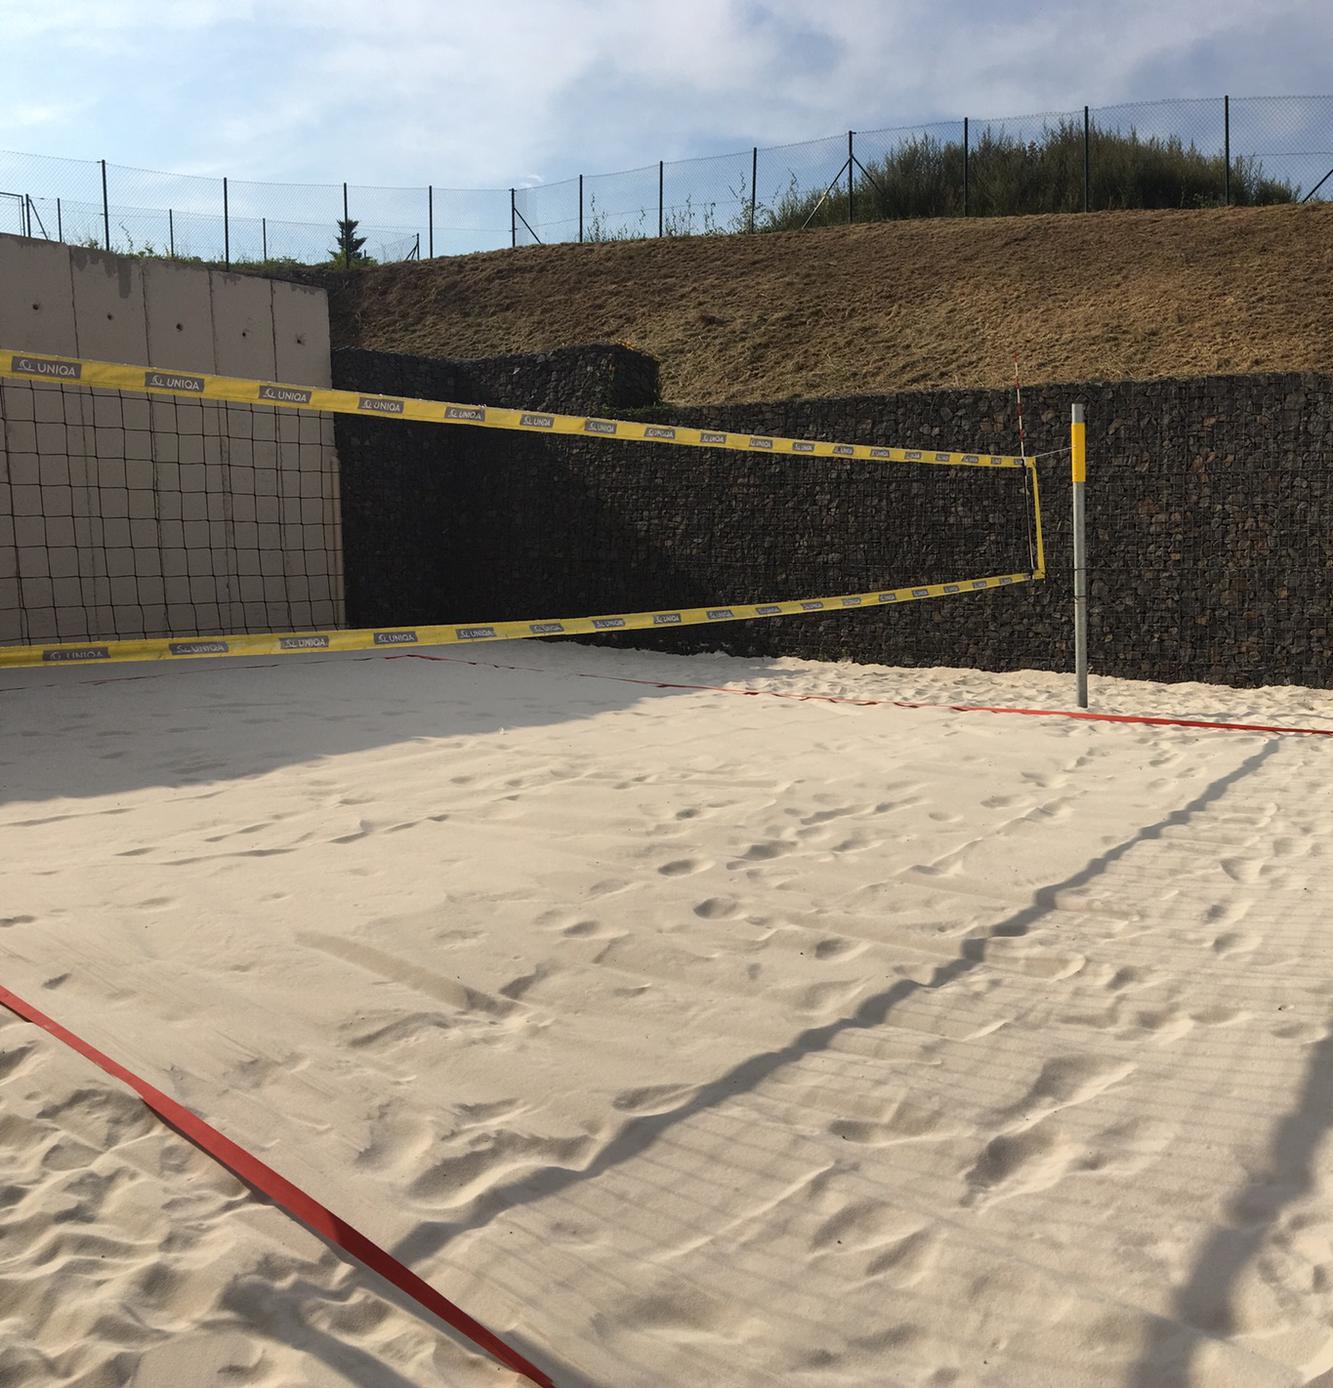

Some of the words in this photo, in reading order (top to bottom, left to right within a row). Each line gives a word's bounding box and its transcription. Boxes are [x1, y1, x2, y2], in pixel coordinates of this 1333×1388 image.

[37, 362, 76, 377] UNIQA
[167, 377, 200, 391] UNIQA
[278, 391, 307, 402] UNIQA
[373, 402, 401, 412] UNIQA
[300, 637, 327, 648] UNIQA
[389, 633, 415, 643] UNIQA
